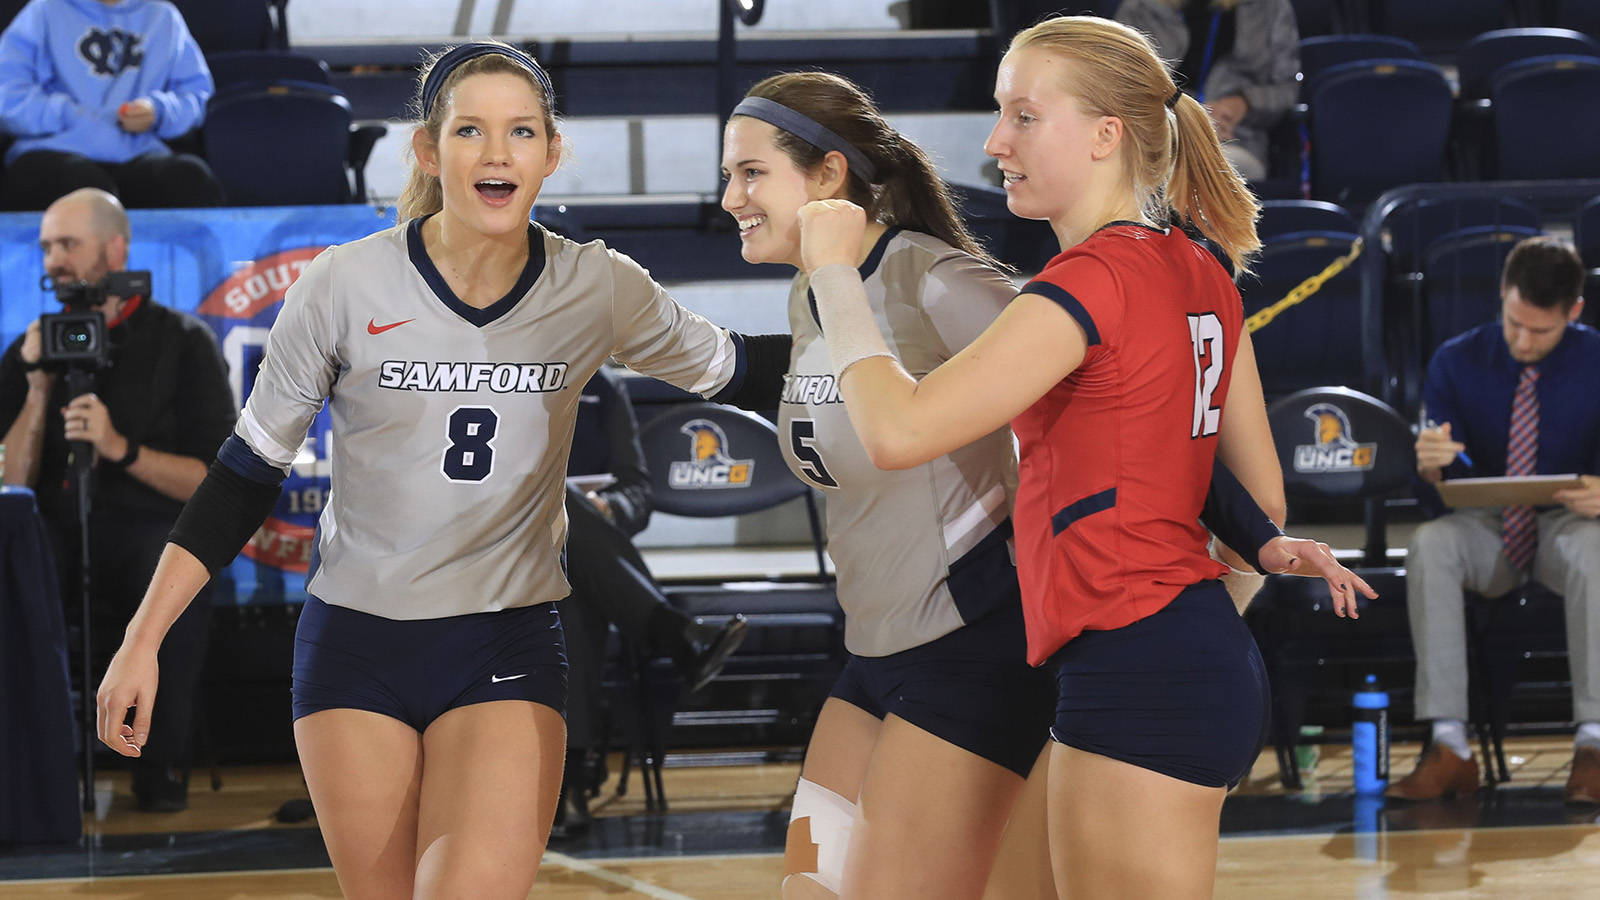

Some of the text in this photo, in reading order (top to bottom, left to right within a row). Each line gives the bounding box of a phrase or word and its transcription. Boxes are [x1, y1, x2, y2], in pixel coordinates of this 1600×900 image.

[378, 360, 567, 393] SAMFORD
[1186, 311, 1224, 440] 12
[440, 404, 500, 484] 8
[790, 418, 840, 489] 5
[1296, 446, 1374, 471] UNCG
[671, 462, 752, 487] UNCG
[287, 486, 329, 513] 19
